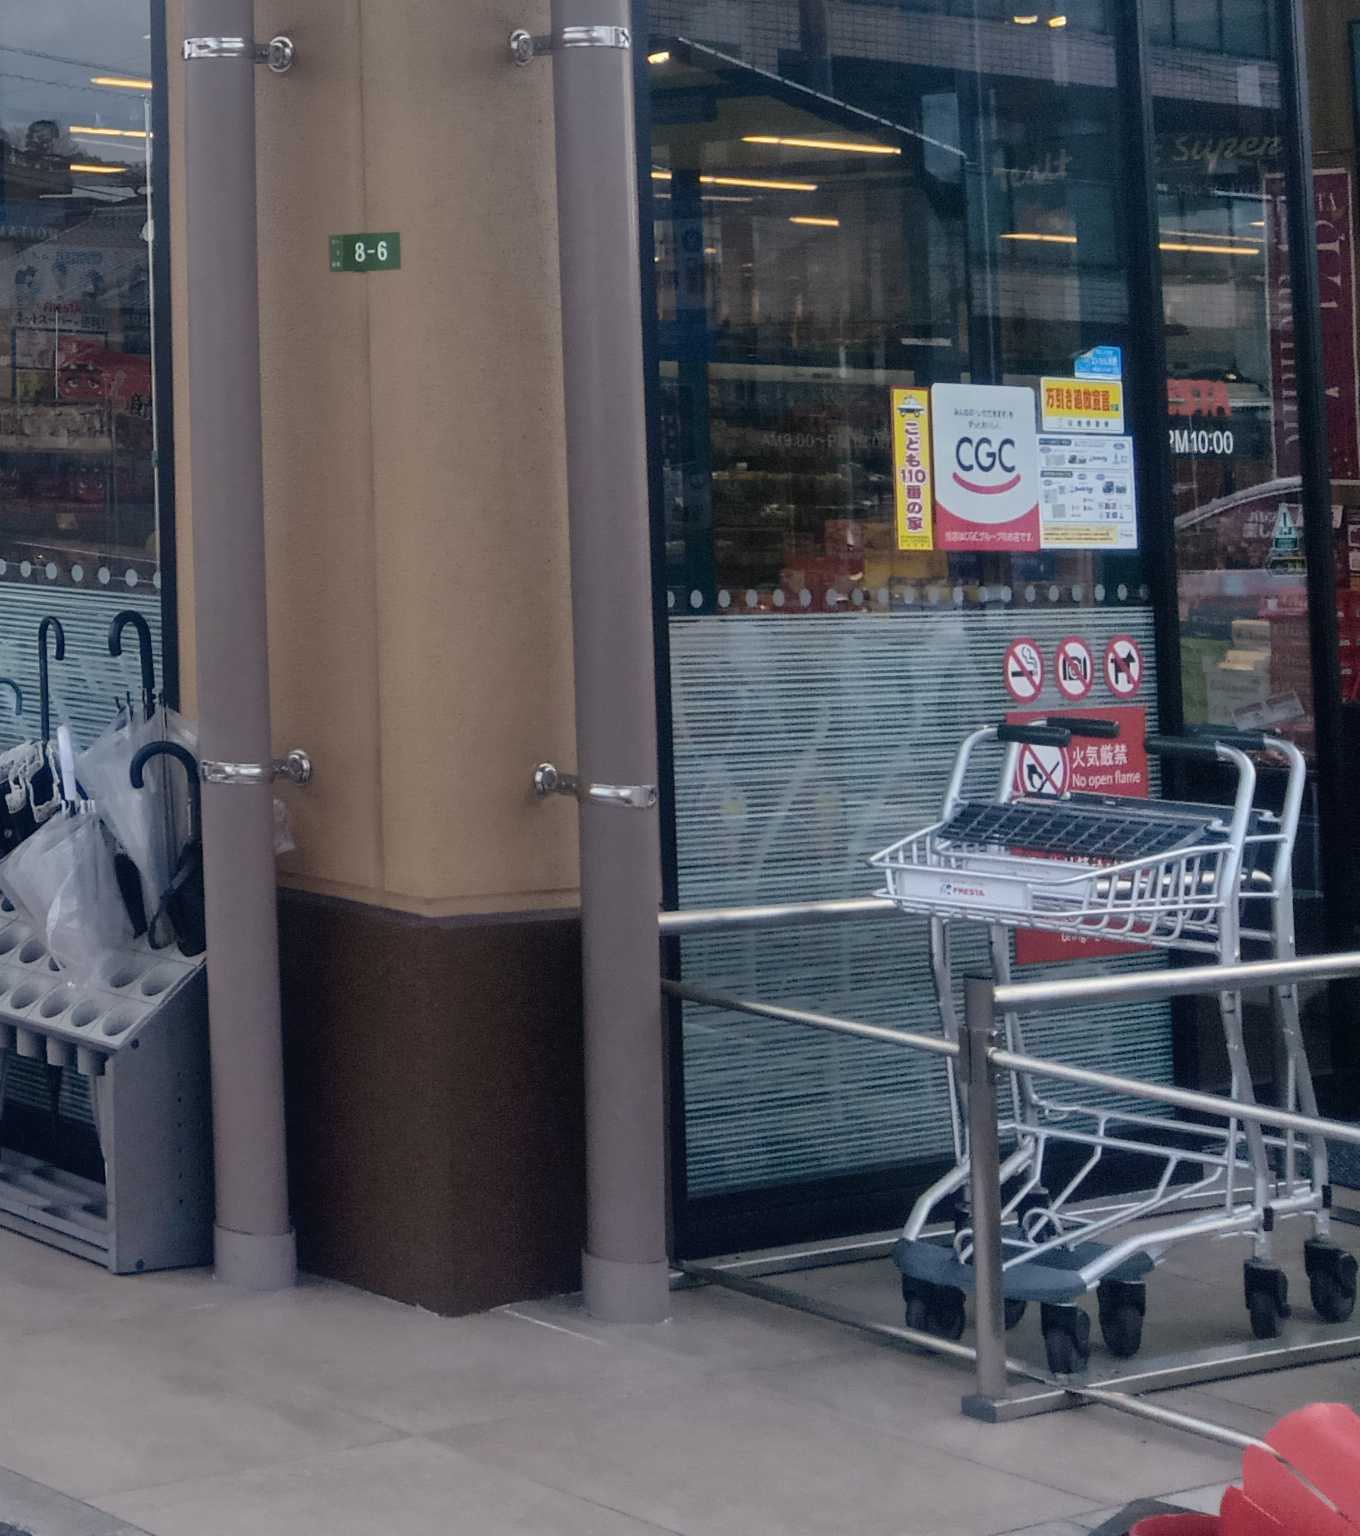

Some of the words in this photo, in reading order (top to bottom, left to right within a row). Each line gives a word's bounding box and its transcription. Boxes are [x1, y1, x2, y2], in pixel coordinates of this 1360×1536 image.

[354, 240, 388, 262] 8-6
[955, 436, 1016, 473] CGC
[900, 421, 926, 531] こども110番の家
[1072, 744, 1128, 768] 火気厳禁
[1072, 774, 1087, 788] No
[1088, 774, 1113, 789] open
[1114, 770, 1141, 785] flame
